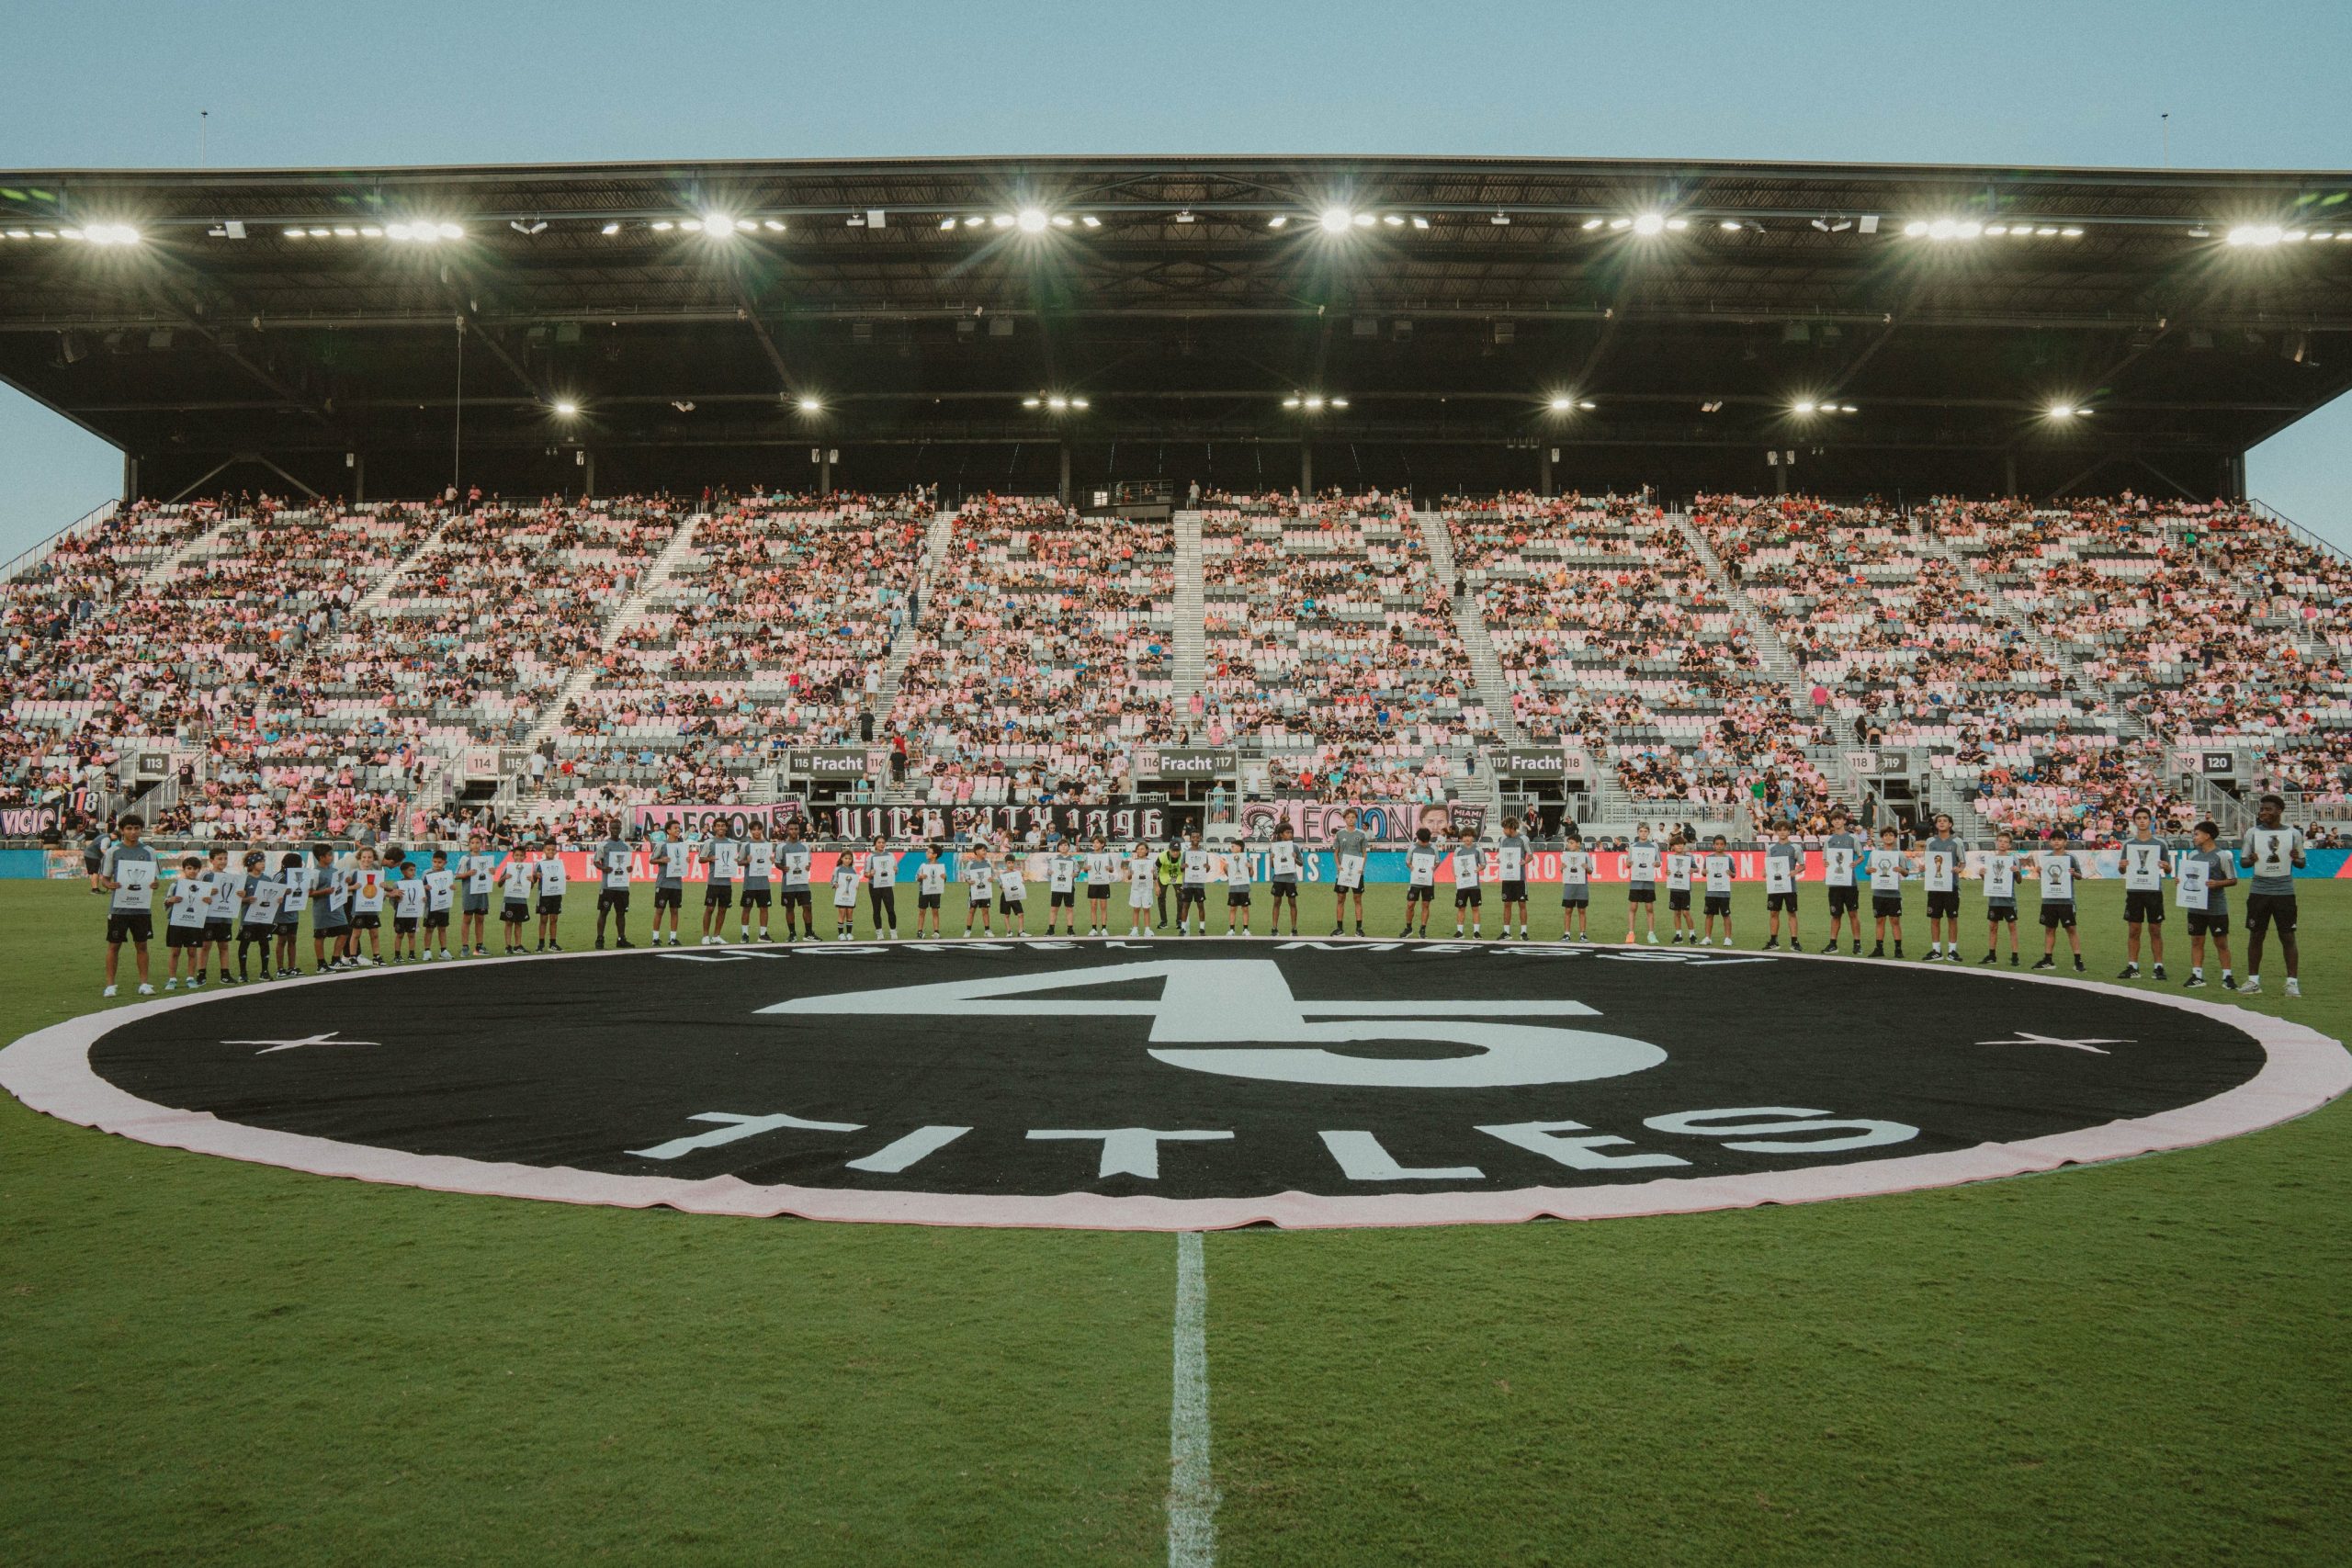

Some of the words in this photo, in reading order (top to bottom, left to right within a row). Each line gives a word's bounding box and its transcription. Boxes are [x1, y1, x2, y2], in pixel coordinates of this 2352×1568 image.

[145, 758, 163, 769] 113
[474, 759, 491, 769] 114
[505, 759, 523, 769] 115
[794, 758, 809, 768] 115
[812, 756, 864, 771] Fracht
[870, 758, 883, 767] 116
[1143, 758, 1159, 767] 116
[1161, 756, 1212, 770] Fracht
[1215, 757, 1232, 767] 117
[1491, 757, 1507, 768] 117
[1511, 755, 1563, 770] Fracht
[1564, 758, 1579, 767] 118
[1852, 758, 1868, 767] 118
[1883, 758, 1900, 768] 119
[2207, 758, 2227, 768] 120
[1453, 809, 1482, 818] MIAMI
[655, 941, 1154, 962] LIONEL
[1273, 942, 1780, 965] MESSI
[752, 958, 1668, 1089] 45
[625, 1106, 1921, 1181] TITLES
